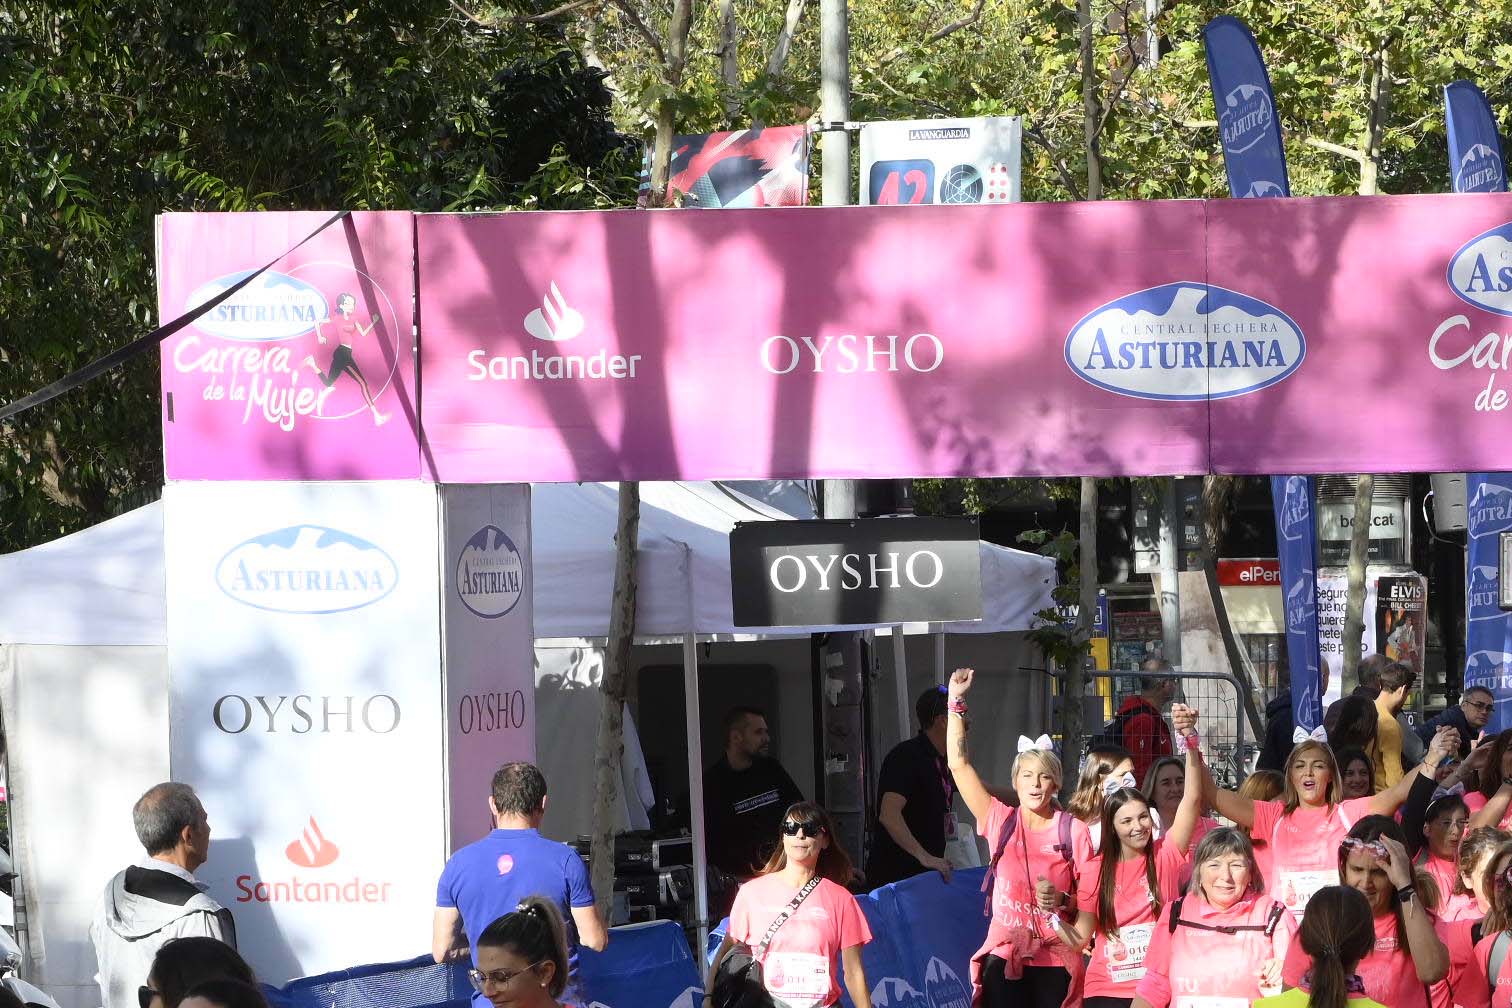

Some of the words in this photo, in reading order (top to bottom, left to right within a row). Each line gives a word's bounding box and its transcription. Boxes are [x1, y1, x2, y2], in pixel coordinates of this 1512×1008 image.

[1121, 323, 1195, 334] CENTRAL
[1203, 322, 1278, 334] LECHERA
[173, 336, 291, 375] Carrera
[468, 349, 642, 381] Santander
[761, 333, 944, 374] OYSHO
[1084, 327, 1287, 370] ASTURIANA
[203, 377, 226, 402] de
[230, 377, 245, 401] la
[244, 366, 336, 431] Mujer
[1475, 373, 1508, 412] de
[231, 560, 384, 593] ASTURIANA
[462, 560, 519, 595] ASTURIANA
[770, 550, 943, 593] OYSHO
[1391, 586, 1421, 598] ELVIS
[213, 694, 401, 734] OYSHO
[460, 690, 525, 734] OYSHO
[236, 875, 391, 903] Santander
